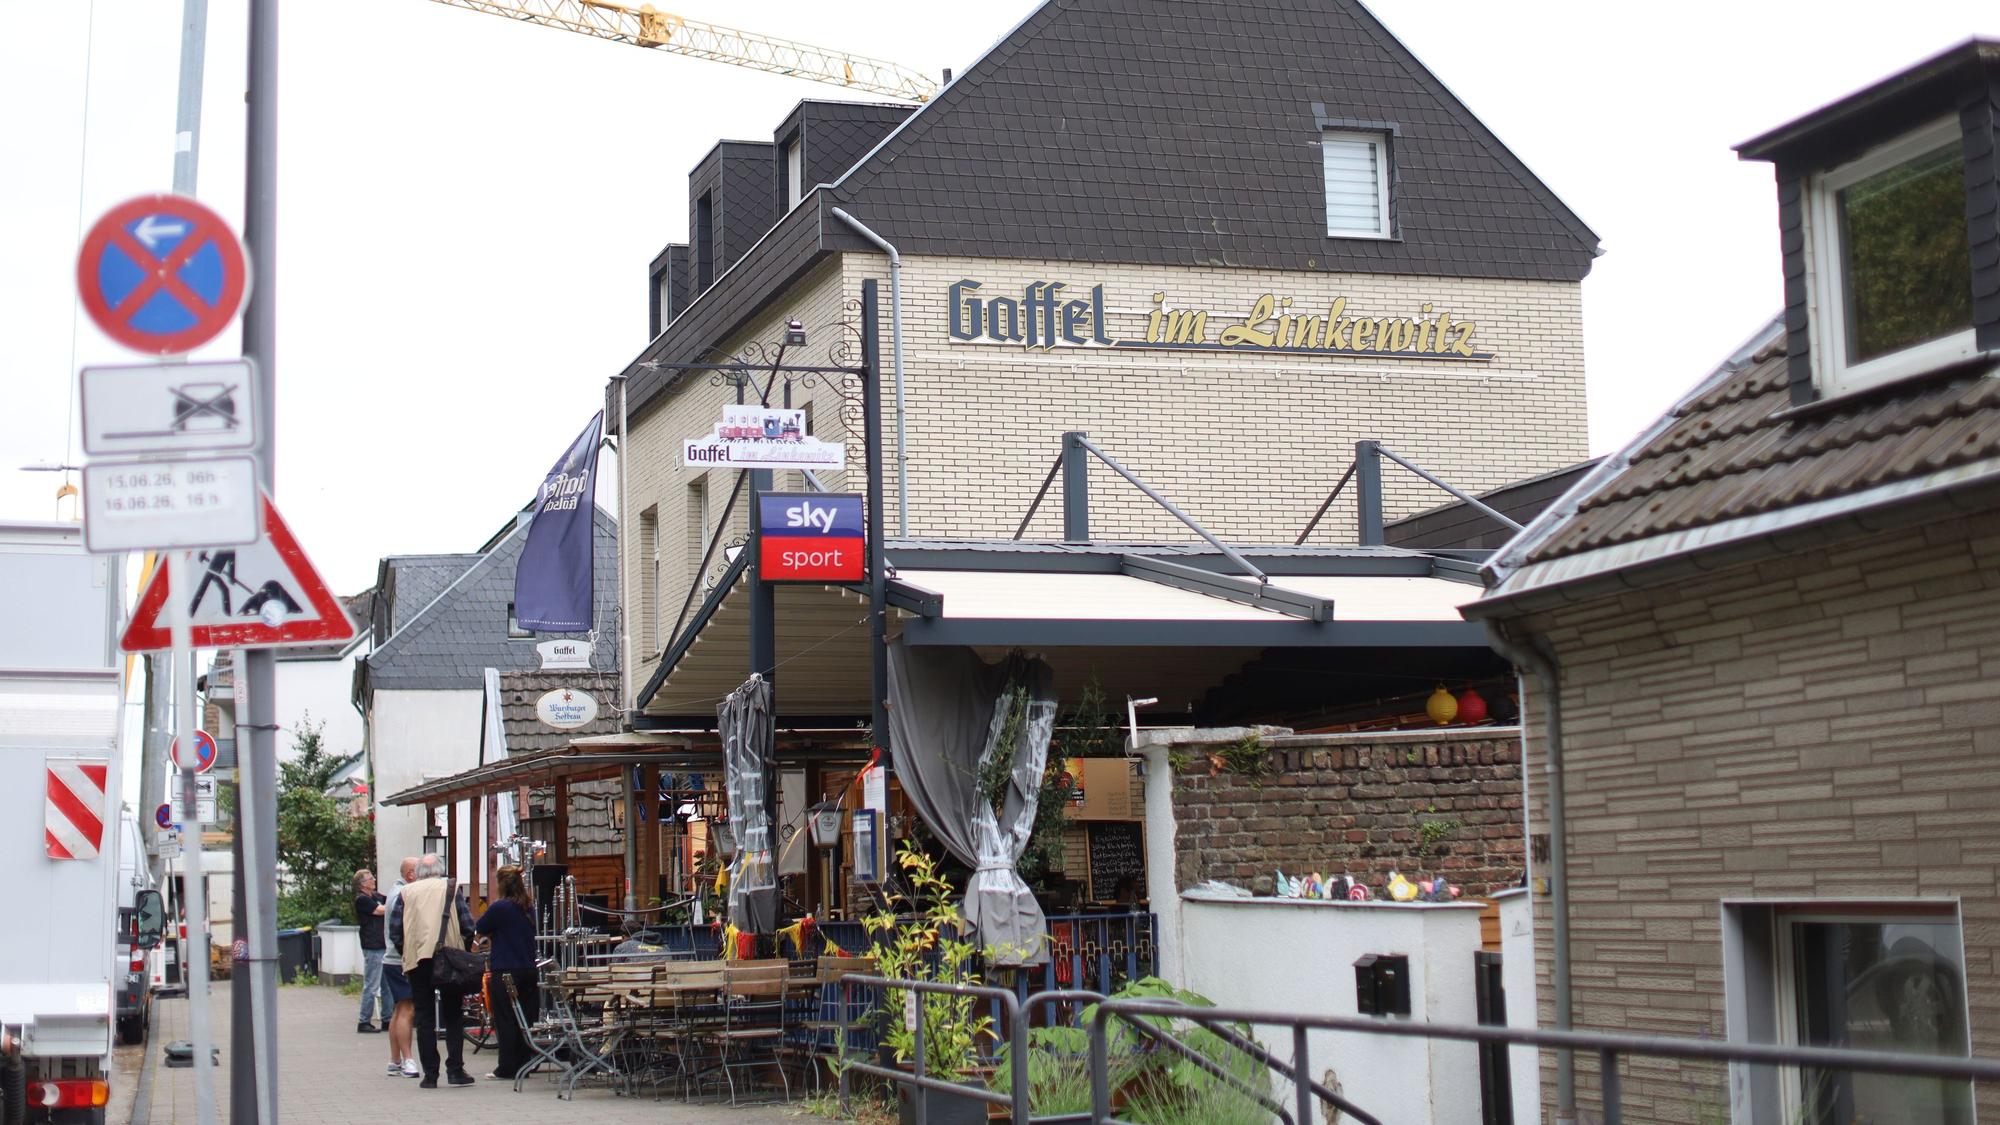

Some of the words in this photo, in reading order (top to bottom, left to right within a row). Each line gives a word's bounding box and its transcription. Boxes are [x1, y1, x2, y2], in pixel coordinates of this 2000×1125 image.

[949, 278, 1117, 352] Gaffel
[1146, 291, 1206, 346] im
[1220, 293, 1475, 357] Linkewitz
[687, 444, 732, 463] Gaffel
[786, 501, 838, 533] sky
[782, 551, 843, 569] sport
[553, 646, 576, 655] Gaffel
